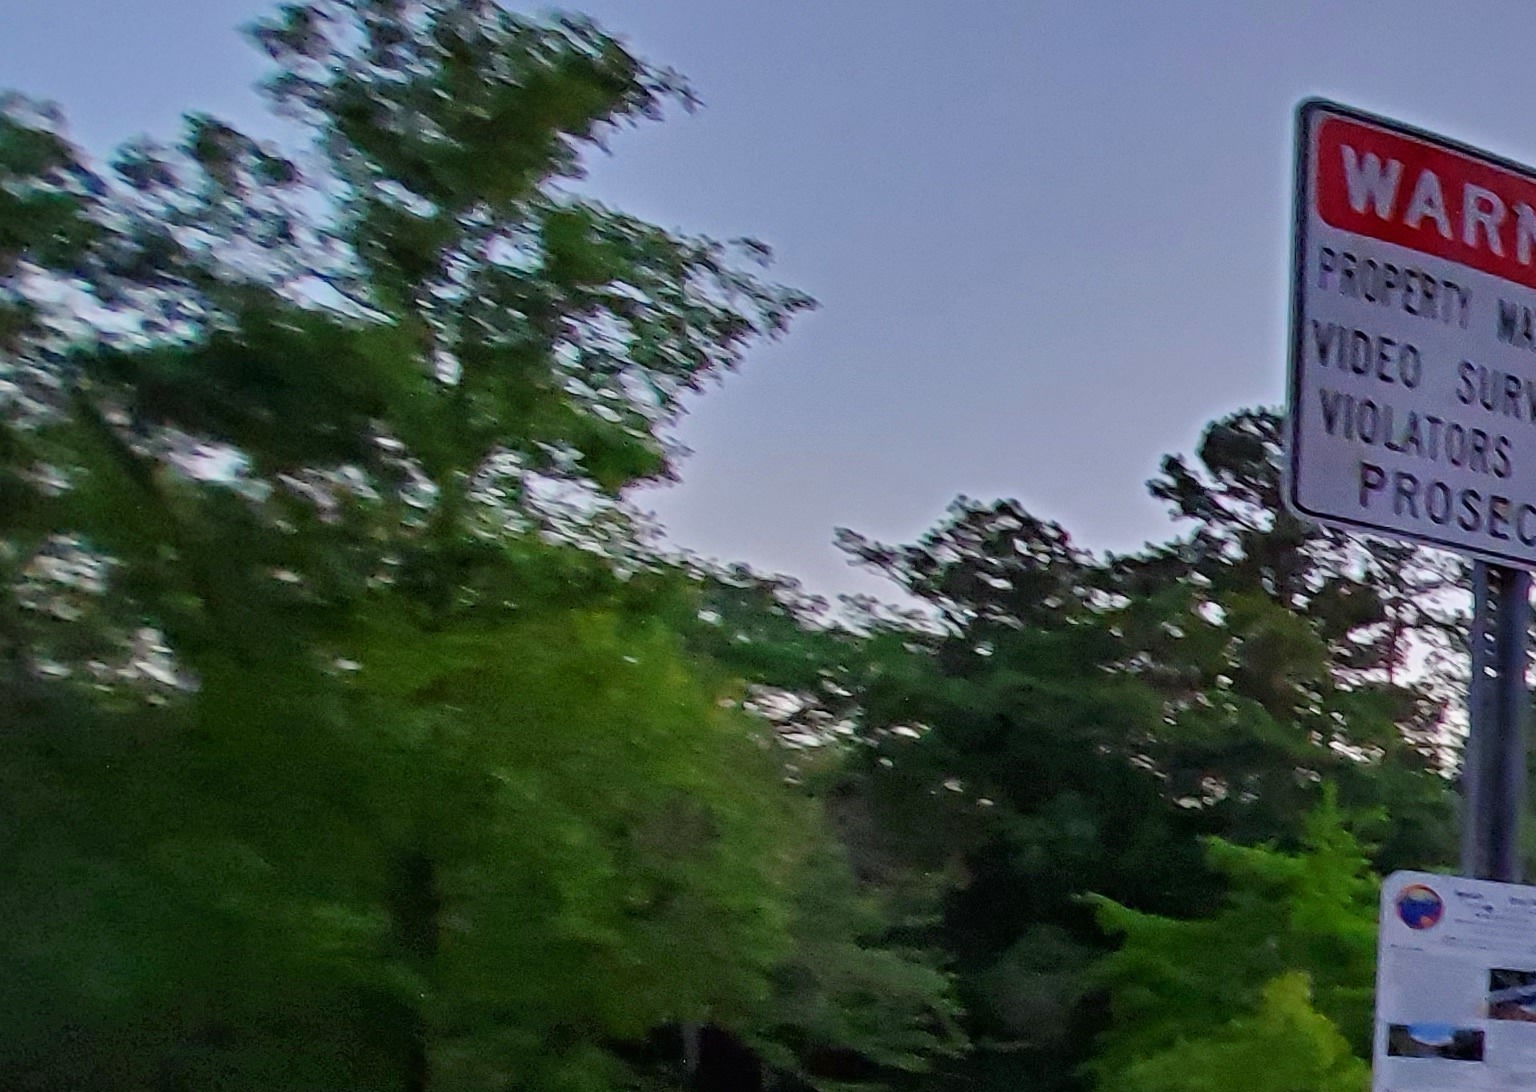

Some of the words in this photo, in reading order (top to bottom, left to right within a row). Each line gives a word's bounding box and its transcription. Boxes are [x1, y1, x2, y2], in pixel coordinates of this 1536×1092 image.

[1318, 246, 1473, 330] PROPERTY
[1312, 319, 1423, 389] VIDEO
[1319, 387, 1512, 479] VIOLATORS
